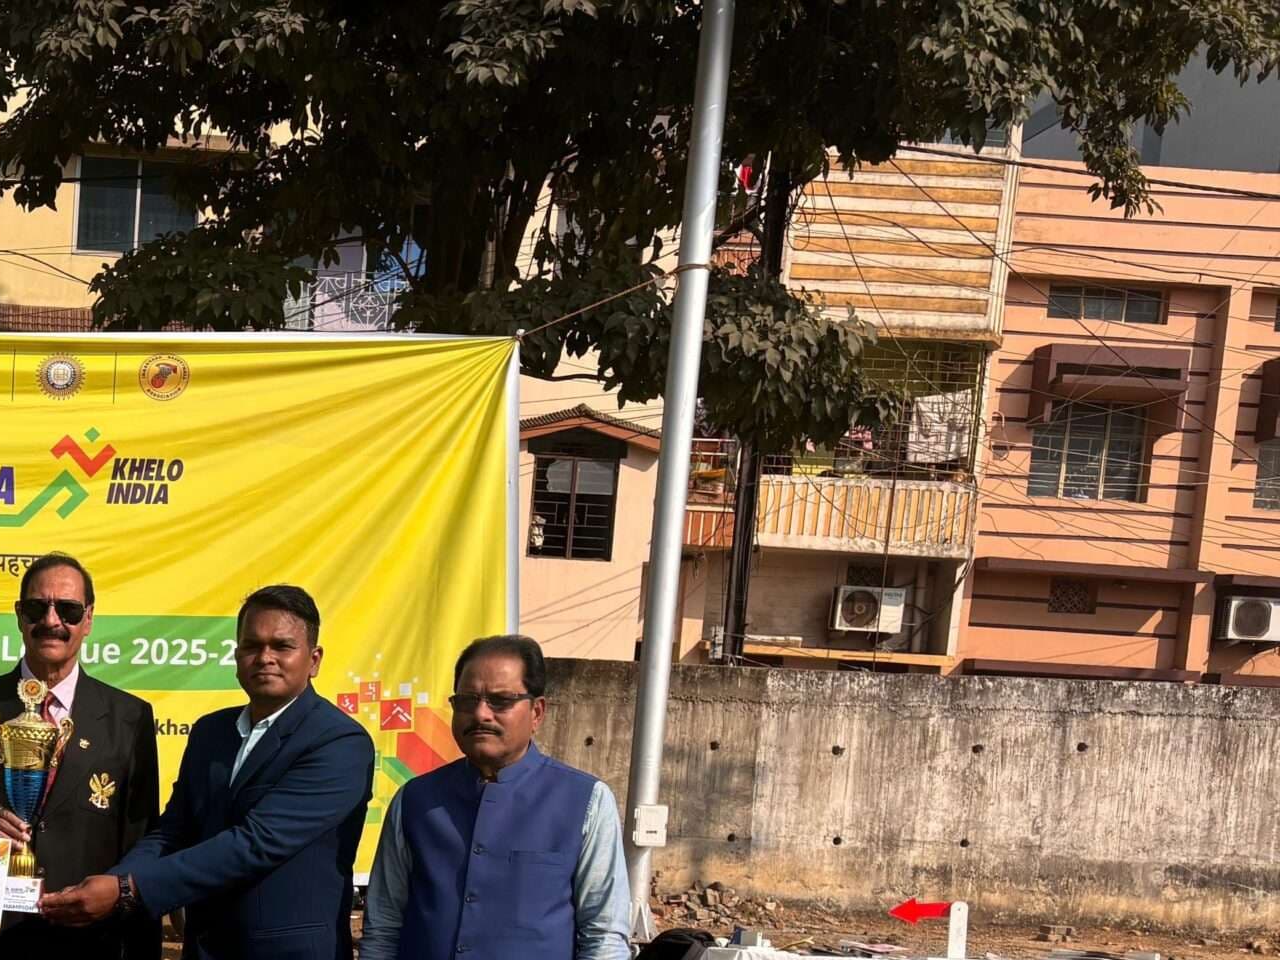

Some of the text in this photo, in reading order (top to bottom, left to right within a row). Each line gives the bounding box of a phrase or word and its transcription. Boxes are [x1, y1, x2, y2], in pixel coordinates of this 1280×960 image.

[111, 457, 185, 482] KHELO
[106, 483, 169, 505] INDIA
[131, 638, 238, 666] 2025-2
